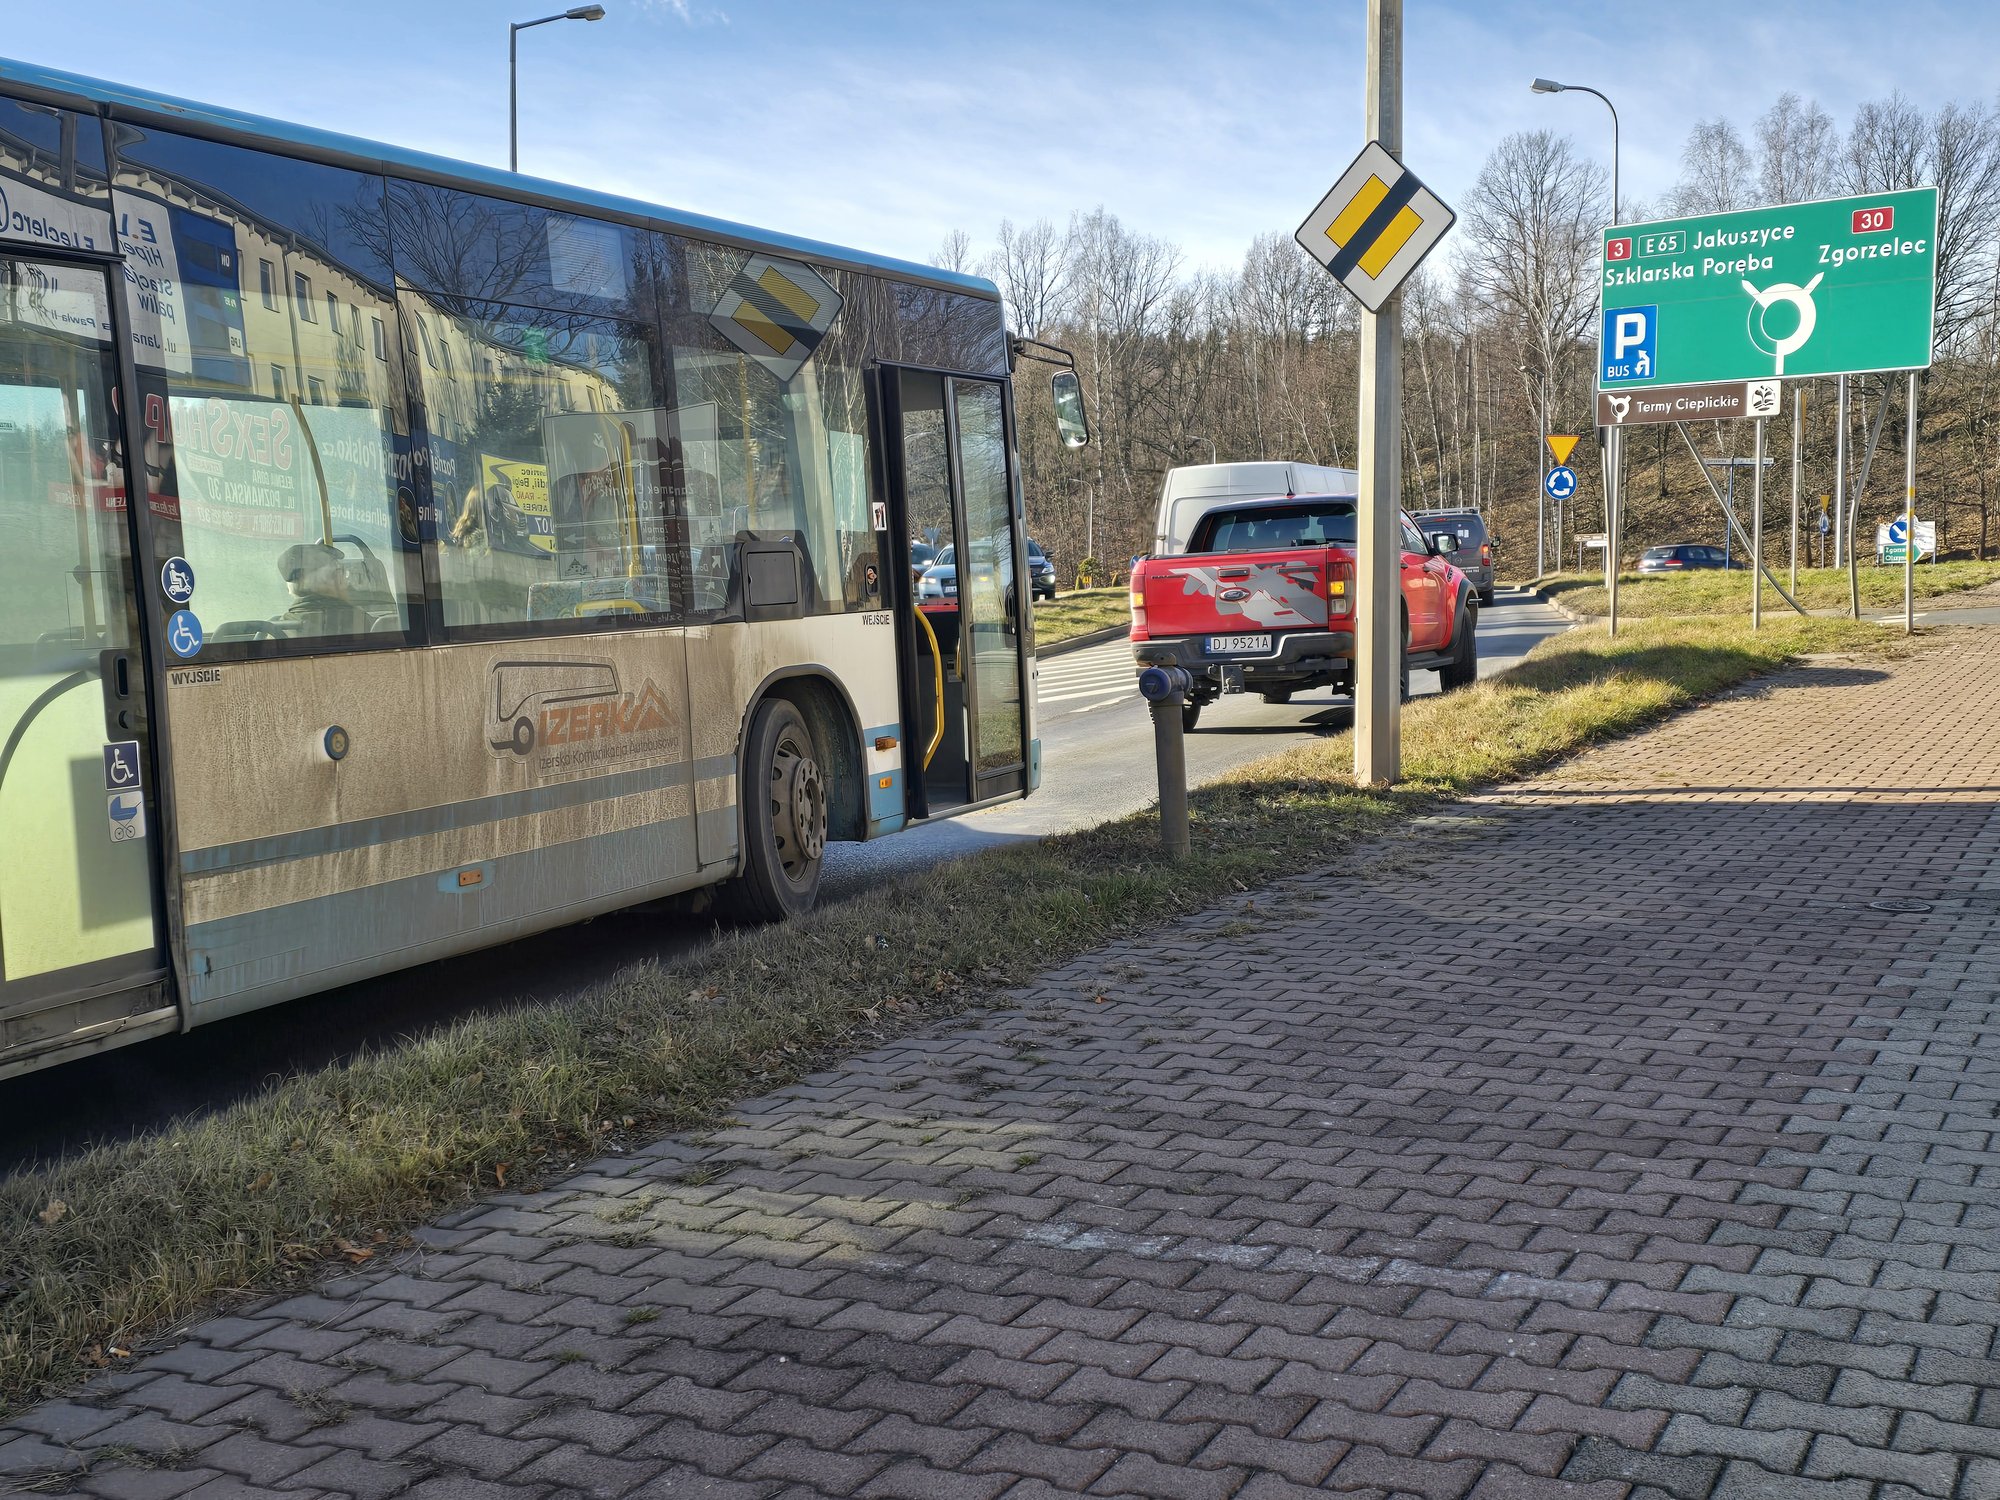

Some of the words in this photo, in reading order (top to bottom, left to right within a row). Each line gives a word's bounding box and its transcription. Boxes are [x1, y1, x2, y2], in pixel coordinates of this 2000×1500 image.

[1861, 213, 1885, 229] 30
[1613, 242, 1625, 258] 3
[1645, 238, 1655, 254] E
[1658, 236, 1678, 252] 65
[1692, 225, 1796, 250] Jakuszyce
[1818, 238, 1927, 268] Zgorzelec
[1605, 264, 1695, 287] Szklarska
[1703, 255, 1774, 277] Poręba
[1615, 313, 1647, 361] P
[1607, 365, 1630, 378] BUS
[1636, 398, 1672, 415] Termy
[1675, 395, 1739, 413] Cieplickie
[862, 612, 890, 625] WEJŚCIE
[1213, 637, 1228, 650] DJ
[1232, 636, 1269, 649] 9521A
[171, 669, 221, 685] WYJŚCIE
